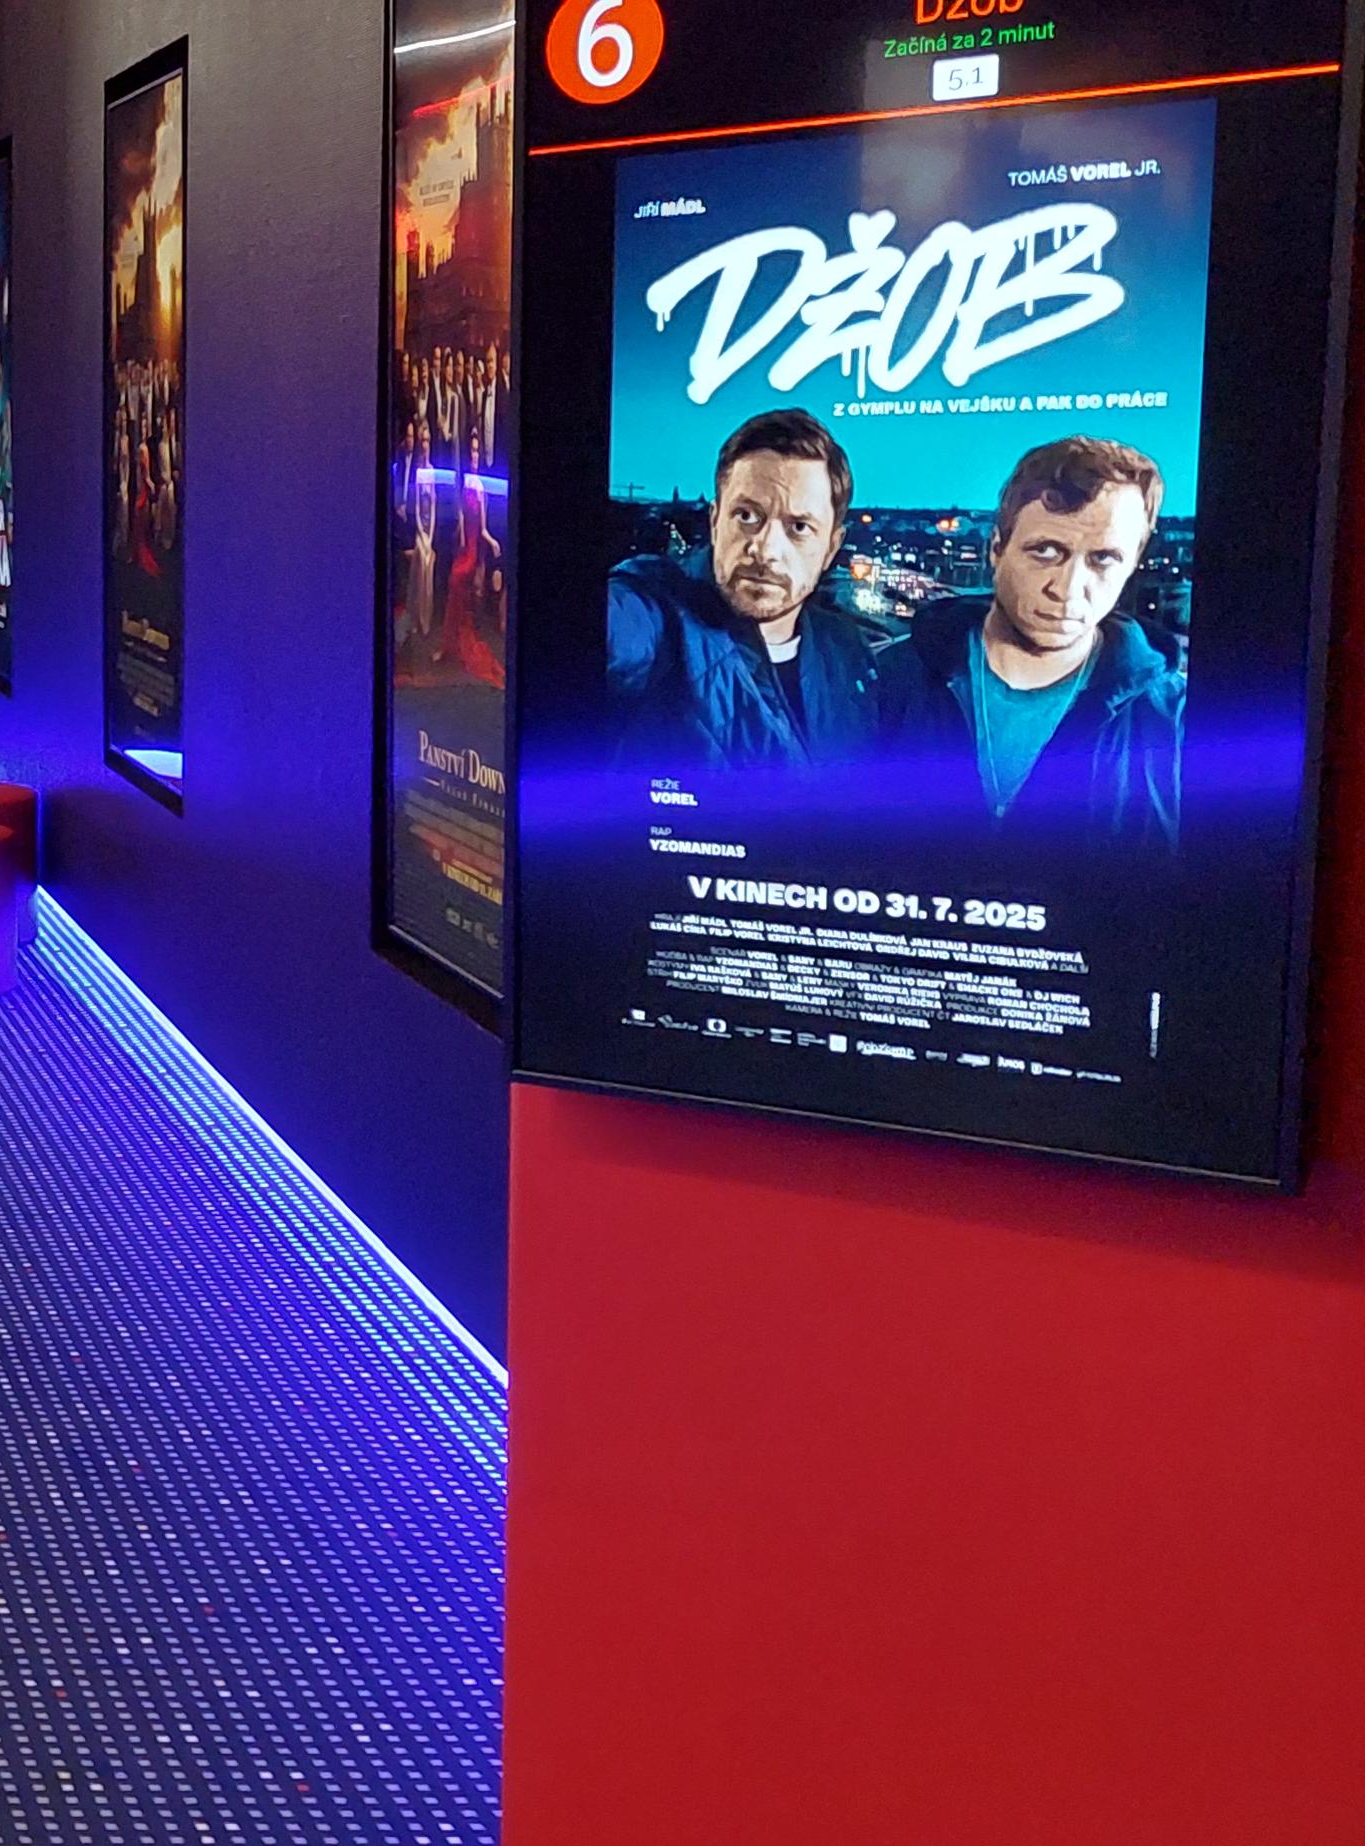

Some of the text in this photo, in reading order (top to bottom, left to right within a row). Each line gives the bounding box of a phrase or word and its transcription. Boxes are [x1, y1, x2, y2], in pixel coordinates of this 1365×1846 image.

[577, 0, 634, 87] 6
[884, 21, 1055, 57] Začíná za 2 minut
[948, 66, 984, 91] 5.1
[1008, 159, 1161, 187] TOMÁŠ VOREL JR.
[661, 197, 706, 217] MÁDL
[646, 203, 1125, 404] DŽOB
[833, 390, 1168, 416] Z GYMPLU NA VEJŠKU A PAK DO PRÁCE
[650, 791, 698, 806] VOREL
[651, 826, 672, 835] RAP
[649, 839, 746, 858] VZOMANDIAS
[687, 875, 1047, 931] V KINECH OD 31. 7. 2025
